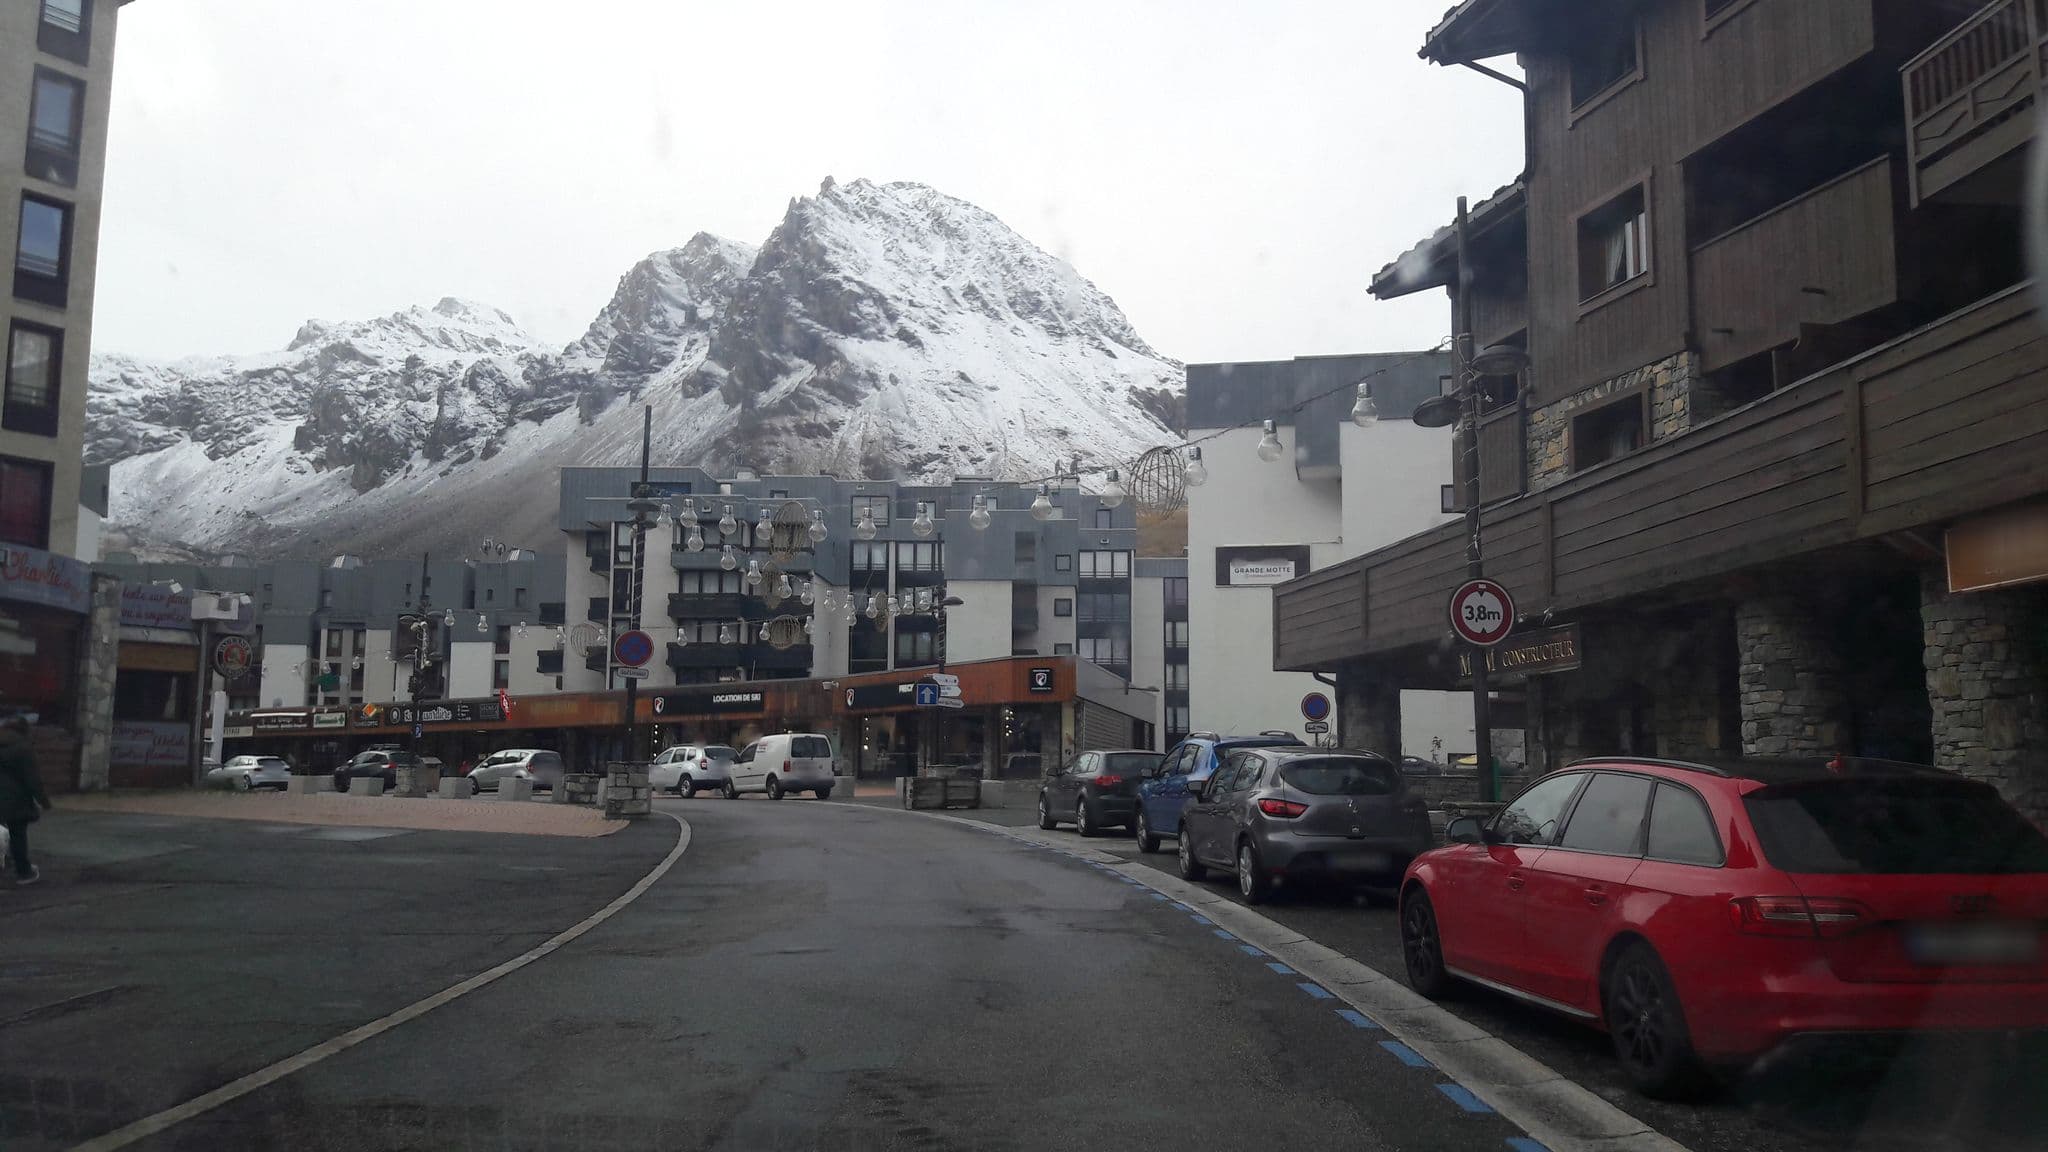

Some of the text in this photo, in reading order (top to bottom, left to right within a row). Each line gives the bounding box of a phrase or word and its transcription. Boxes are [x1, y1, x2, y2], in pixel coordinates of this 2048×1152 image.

[1464, 605, 1501, 623] 3,8m
[1502, 640, 1575, 667] CONSTRUCTEUR
[713, 693, 761, 704] LOCATION DE SKI
